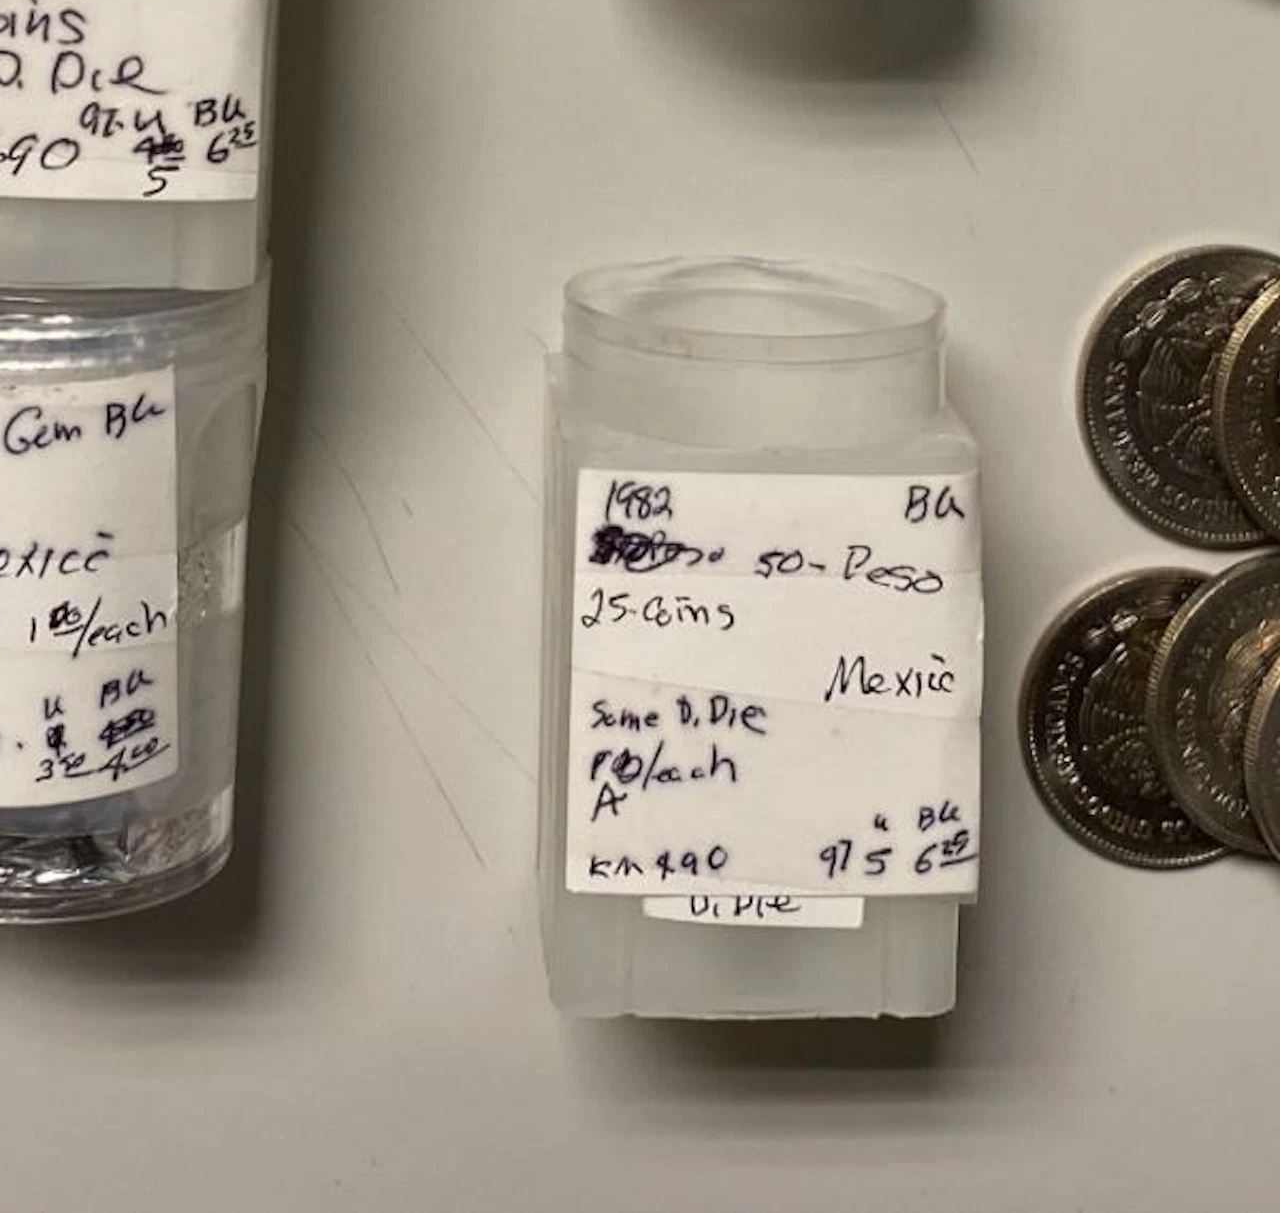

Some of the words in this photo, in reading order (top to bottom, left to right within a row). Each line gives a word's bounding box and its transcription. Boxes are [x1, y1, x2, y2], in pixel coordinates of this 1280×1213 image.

[52, 51, 167, 94] Die
[4, 406, 82, 455] Gem
[606, 481, 673, 521] 1982
[844, 546, 944, 594] Peso
[825, 654, 956, 701] Mexico
[591, 699, 660, 732] Some
[709, 695, 767, 733] Die
[820, 841, 852, 880] 97
[865, 849, 892, 875] 5
